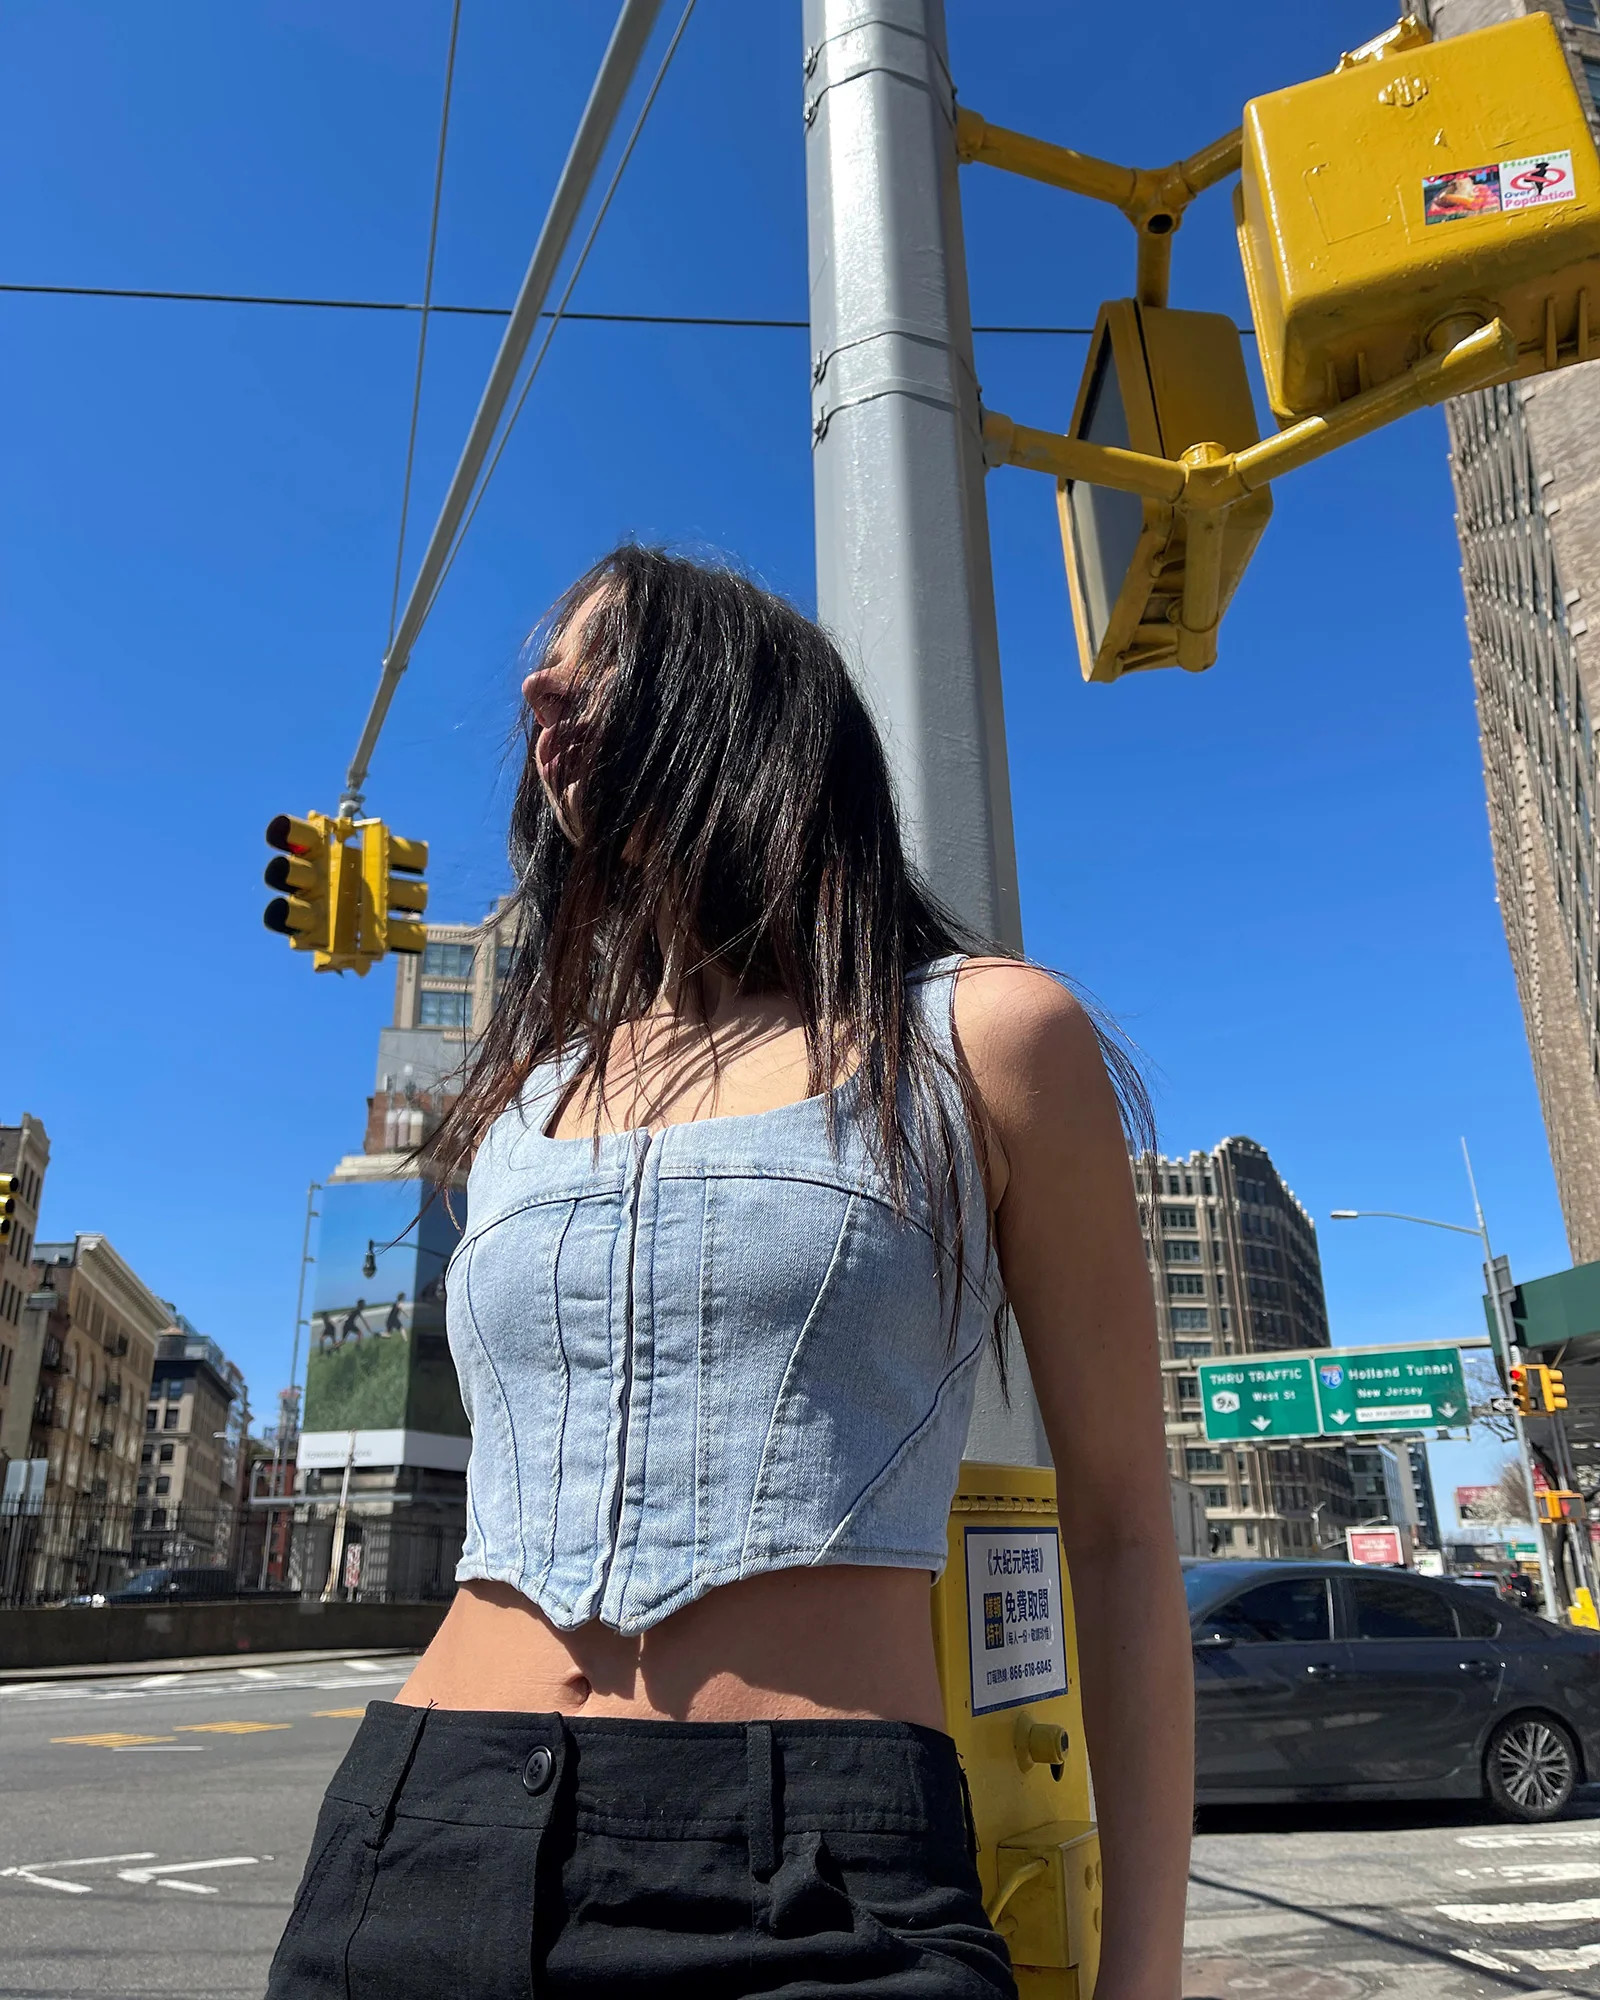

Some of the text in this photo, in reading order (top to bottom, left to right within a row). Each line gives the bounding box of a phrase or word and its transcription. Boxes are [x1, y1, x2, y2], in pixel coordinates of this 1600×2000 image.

[1504, 189, 1530, 199] Over
[1209, 1368, 1302, 1386] THRU TRAFFIC
[1348, 1362, 1454, 1381] Holland Tunnel
[1323, 1372, 1341, 1385] 78
[1252, 1389, 1296, 1402] West St
[1357, 1386, 1423, 1399] New Jersey
[1216, 1396, 1236, 1410] 9A
